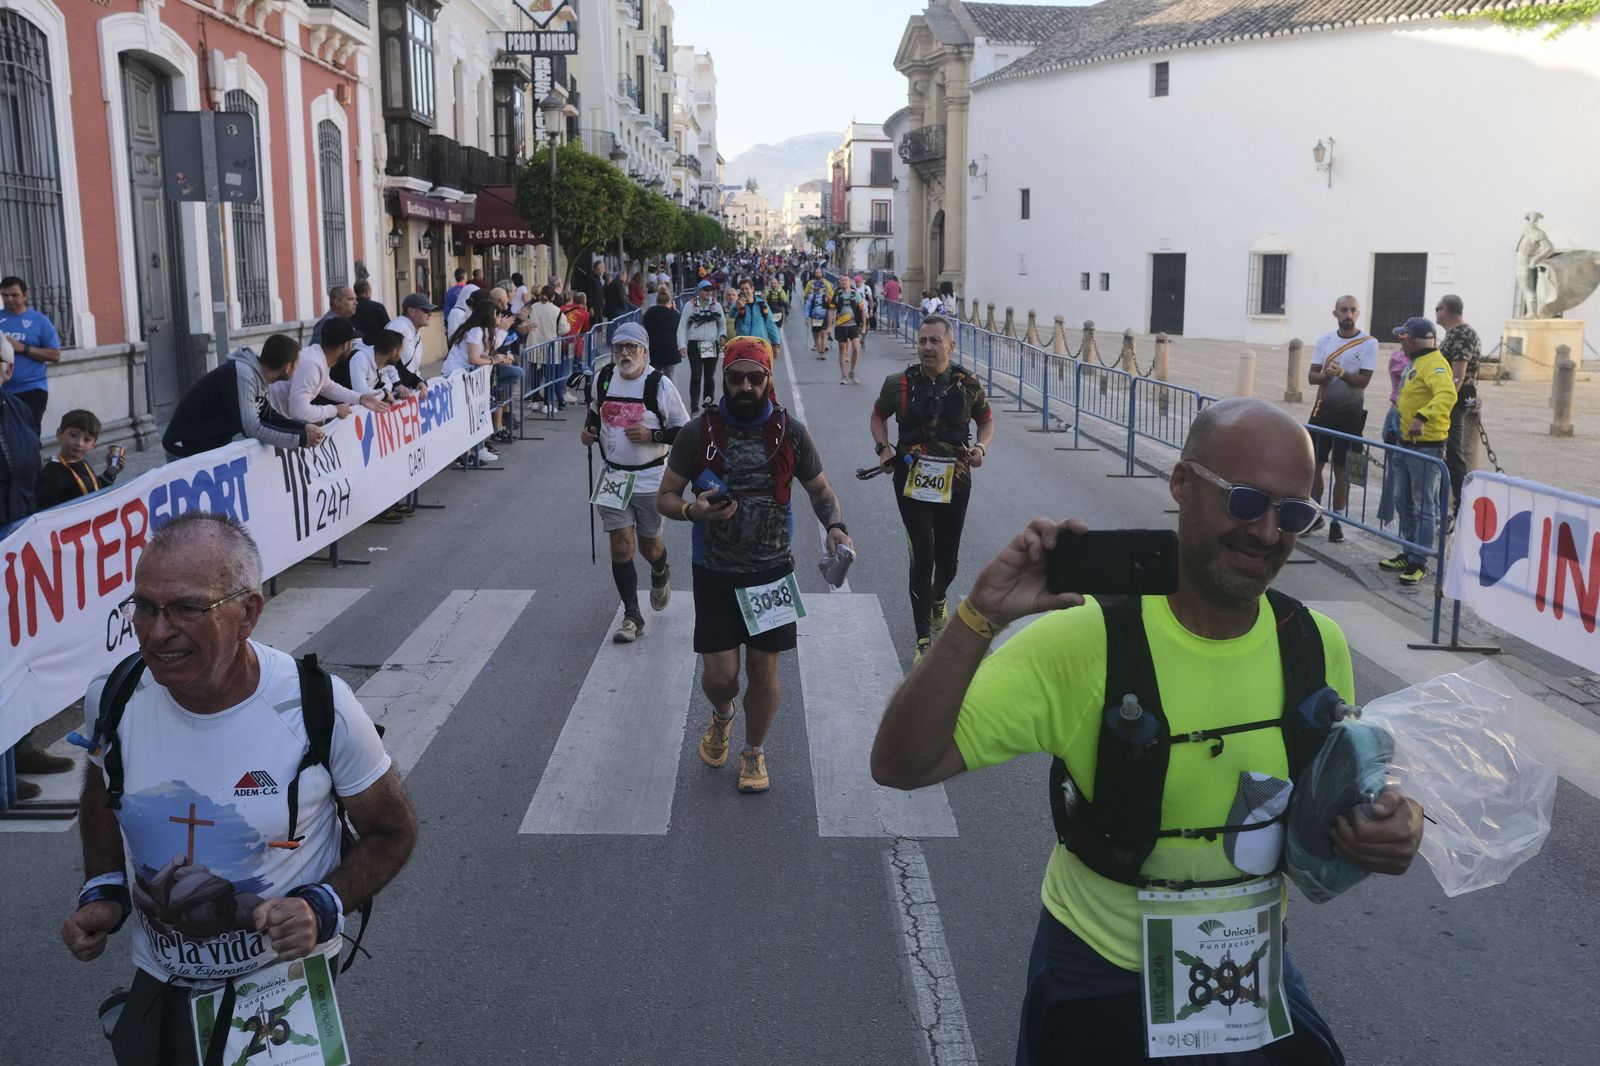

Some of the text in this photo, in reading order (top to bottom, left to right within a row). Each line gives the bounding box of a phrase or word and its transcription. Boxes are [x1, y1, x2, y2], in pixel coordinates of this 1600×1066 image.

[508, 33, 576, 52] PEDRO ROMERO
[374, 383, 454, 459] INTERSPORT
[408, 445, 426, 477] CARY
[914, 474, 945, 490] 6240
[316, 478, 350, 531] 24H
[751, 586, 791, 613] 3038
[233, 787, 279, 797] ADEM-C.G.
[1223, 924, 1256, 938] Unicaja
[172, 931, 203, 965] la
[206, 928, 266, 965] vida
[1200, 939, 1255, 950] Fundación
[179, 963, 191, 975] la
[195, 961, 260, 978] Esperanza
[256, 977, 286, 993] Unicaja
[1189, 959, 1260, 1007] 891
[238, 986, 286, 1010] Fundación
[319, 1002, 335, 1038] EDICIÓN
